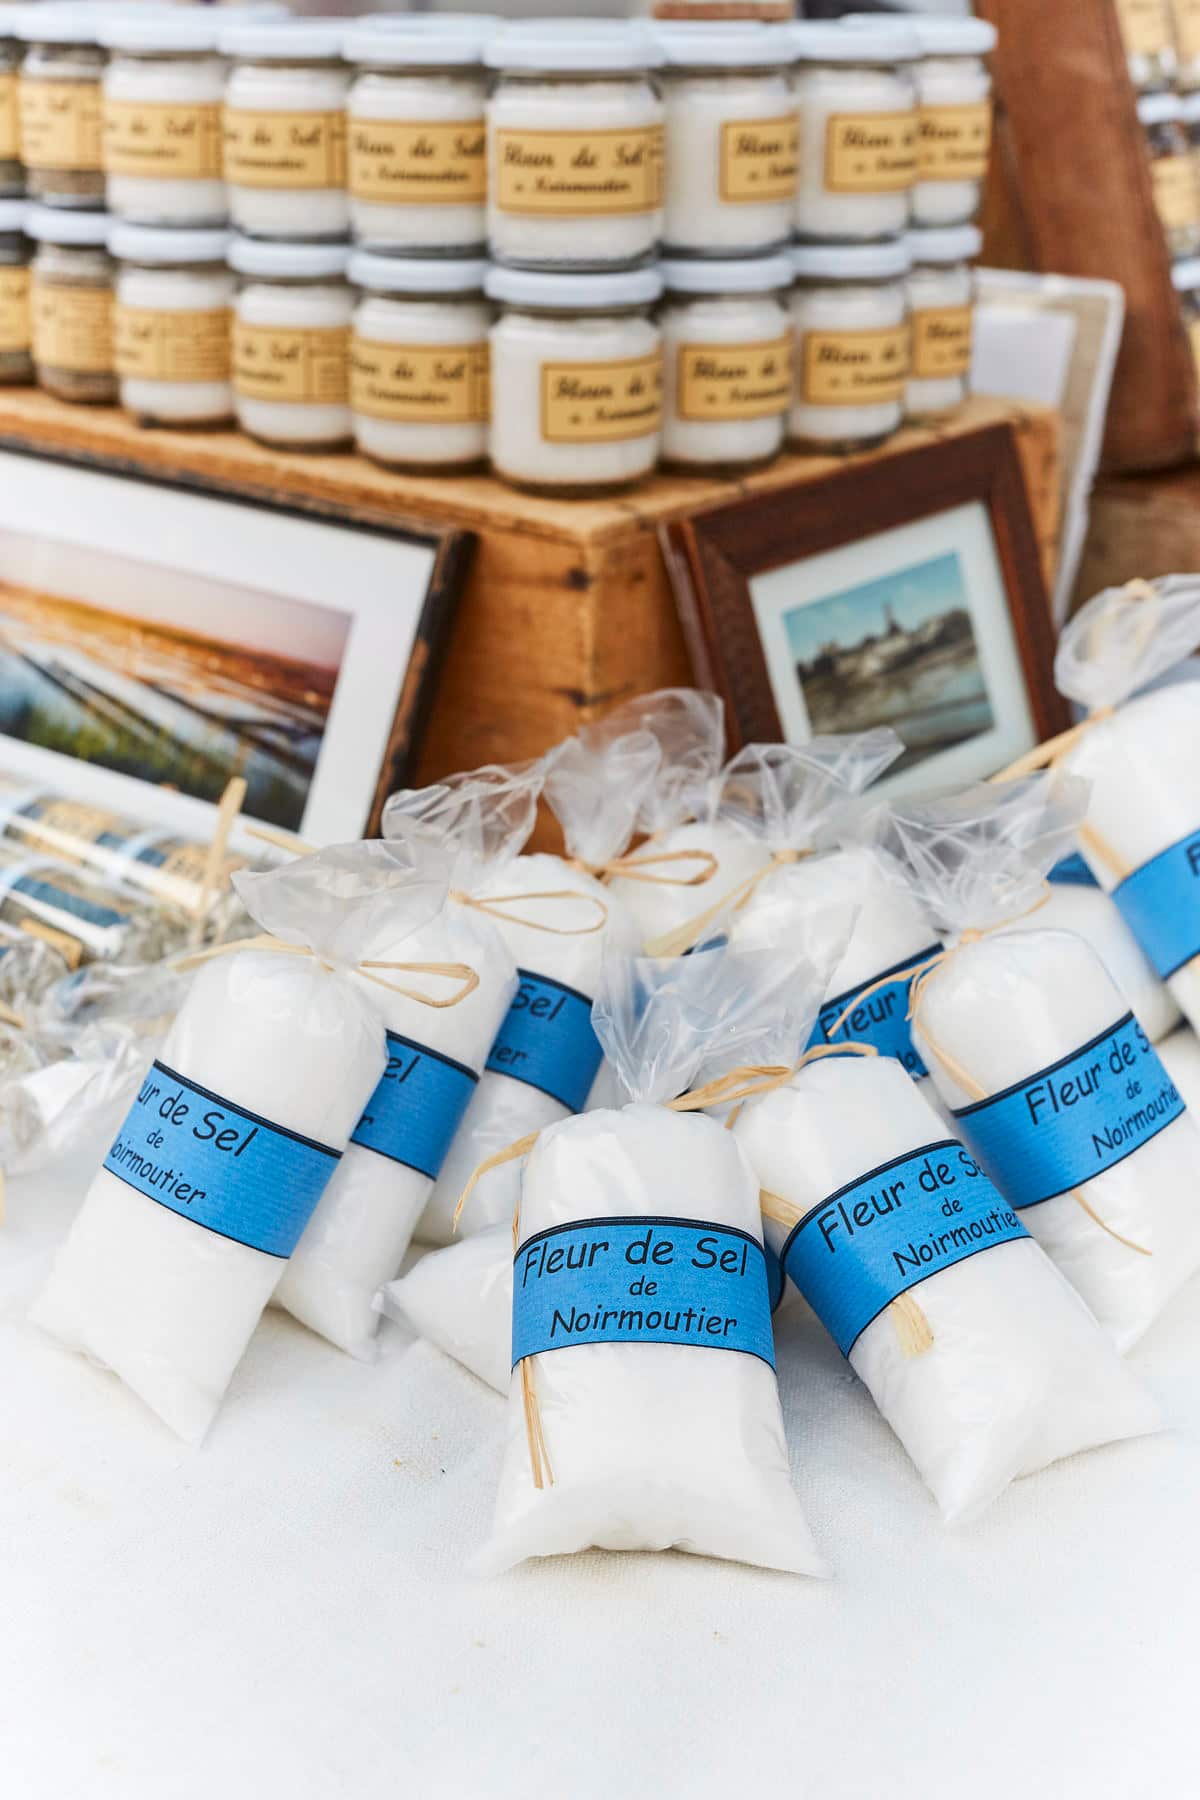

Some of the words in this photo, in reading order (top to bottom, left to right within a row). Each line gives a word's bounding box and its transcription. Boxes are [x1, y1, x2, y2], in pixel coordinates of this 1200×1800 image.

[509, 982, 567, 1022] Sel
[383, 1054, 421, 1084] el
[1025, 1062, 1102, 1126] Fleur
[1109, 1039, 1137, 1075] de
[1125, 1078, 1143, 1100] de
[146, 1128, 165, 1150] de
[159, 1089, 189, 1127] de
[192, 1112, 260, 1158] Sel
[816, 1180, 906, 1254] Fleur
[918, 1158, 956, 1193] de
[941, 1197, 964, 1217] de
[522, 1239, 610, 1288] Fleur
[625, 1229, 674, 1266] de
[691, 1237, 748, 1276] Sel
[629, 1275, 658, 1296] de
[550, 1304, 737, 1338] Noirmoutier
